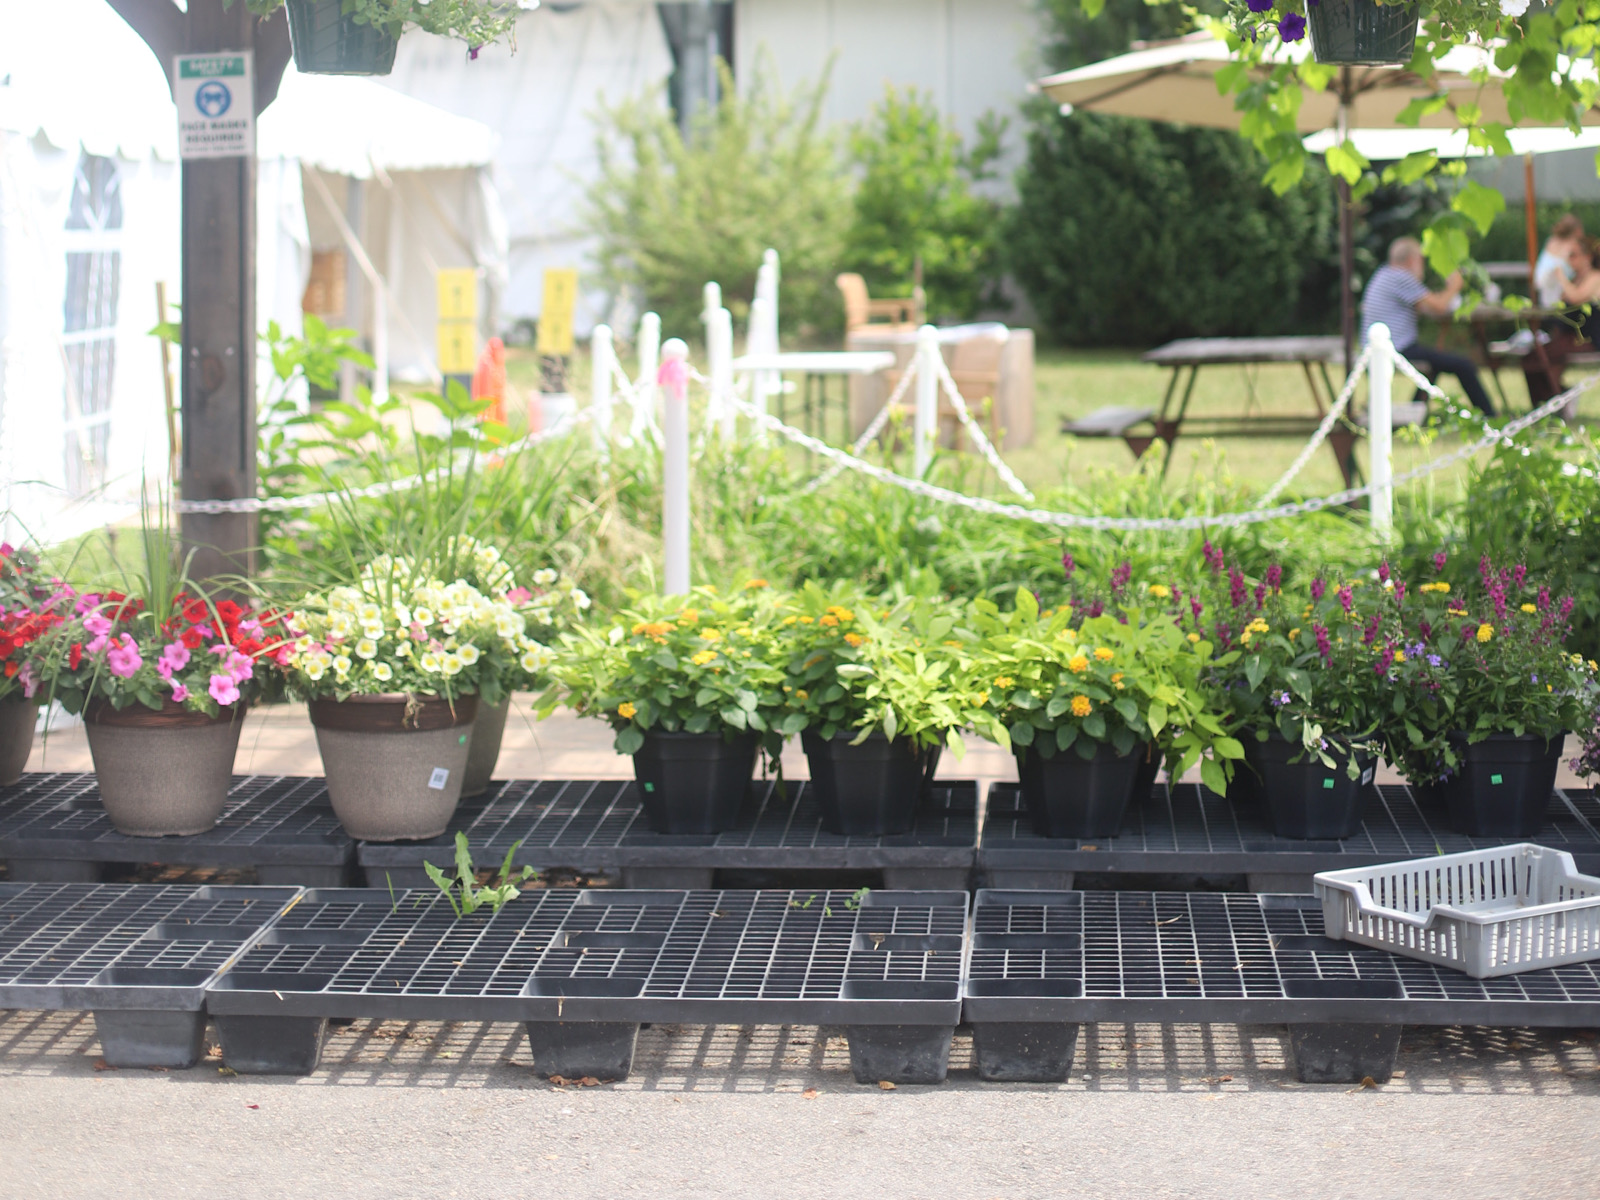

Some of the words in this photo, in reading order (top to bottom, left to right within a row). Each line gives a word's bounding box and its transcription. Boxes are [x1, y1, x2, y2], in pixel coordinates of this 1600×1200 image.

[181, 121, 206, 131] FACE
[210, 119, 247, 130] MASKS
[186, 132, 243, 144] REQUIRED
